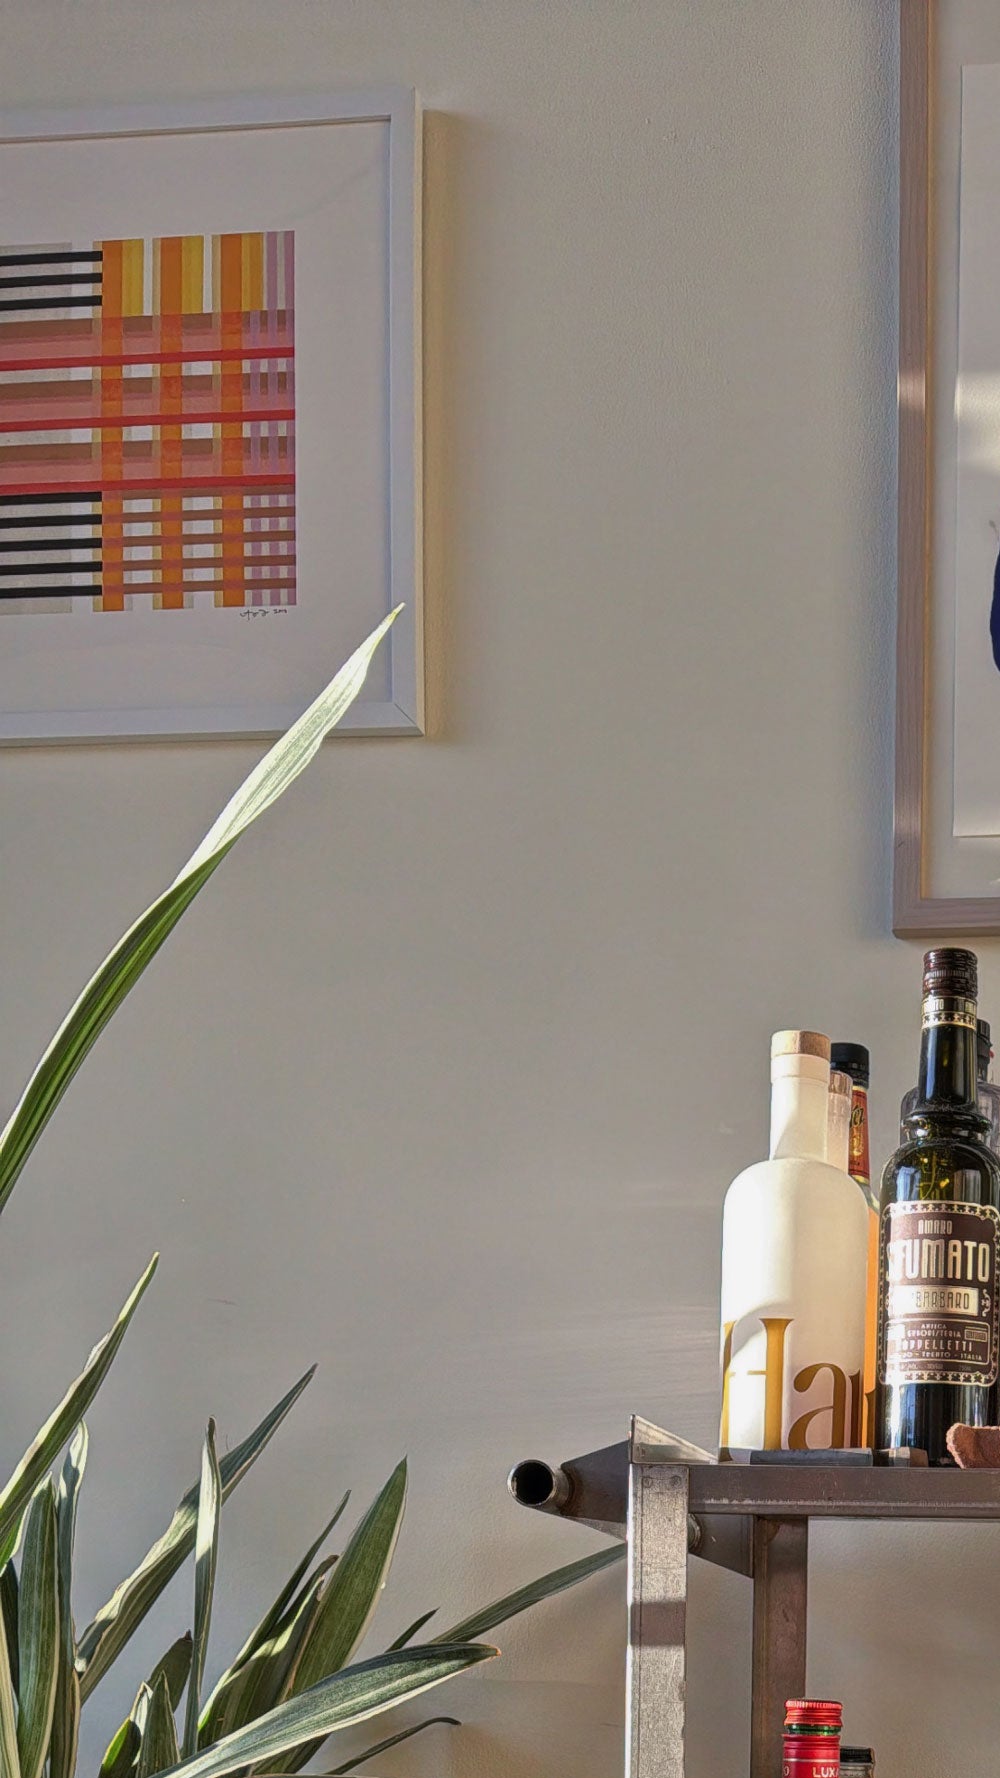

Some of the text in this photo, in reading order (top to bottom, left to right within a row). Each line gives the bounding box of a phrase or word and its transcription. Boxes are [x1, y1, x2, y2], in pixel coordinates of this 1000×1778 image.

[918, 1219, 953, 1235] AMARO
[914, 1291, 970, 1310] BARBARO
[897, 1339, 973, 1351] APPELLETTI
[960, 1352, 982, 1361] ITALIA
